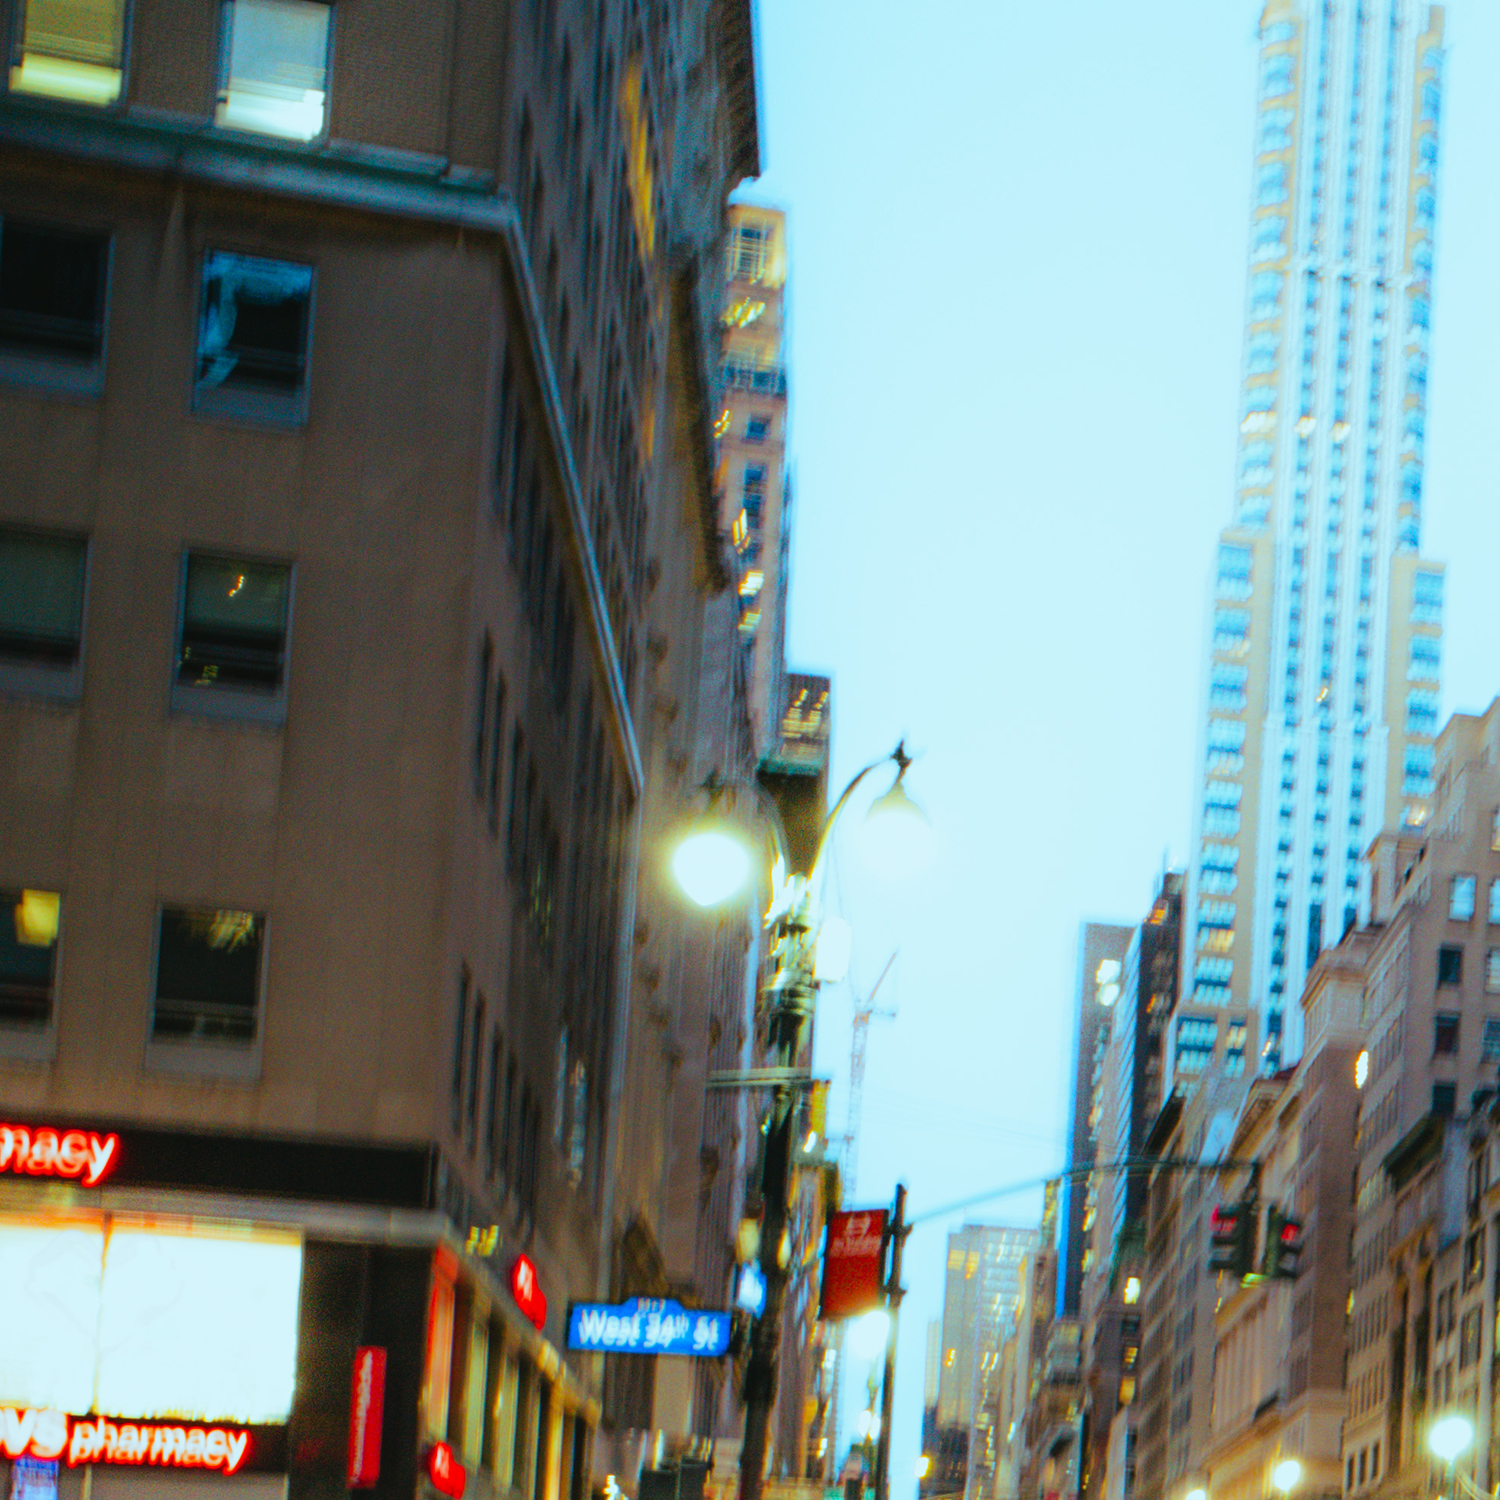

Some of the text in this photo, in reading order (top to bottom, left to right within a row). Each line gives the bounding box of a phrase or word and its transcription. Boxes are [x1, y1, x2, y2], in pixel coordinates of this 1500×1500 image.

[578, 1308, 641, 1347] West
[692, 1315, 720, 1350] St
[68, 1416, 249, 1473] pharmacy
